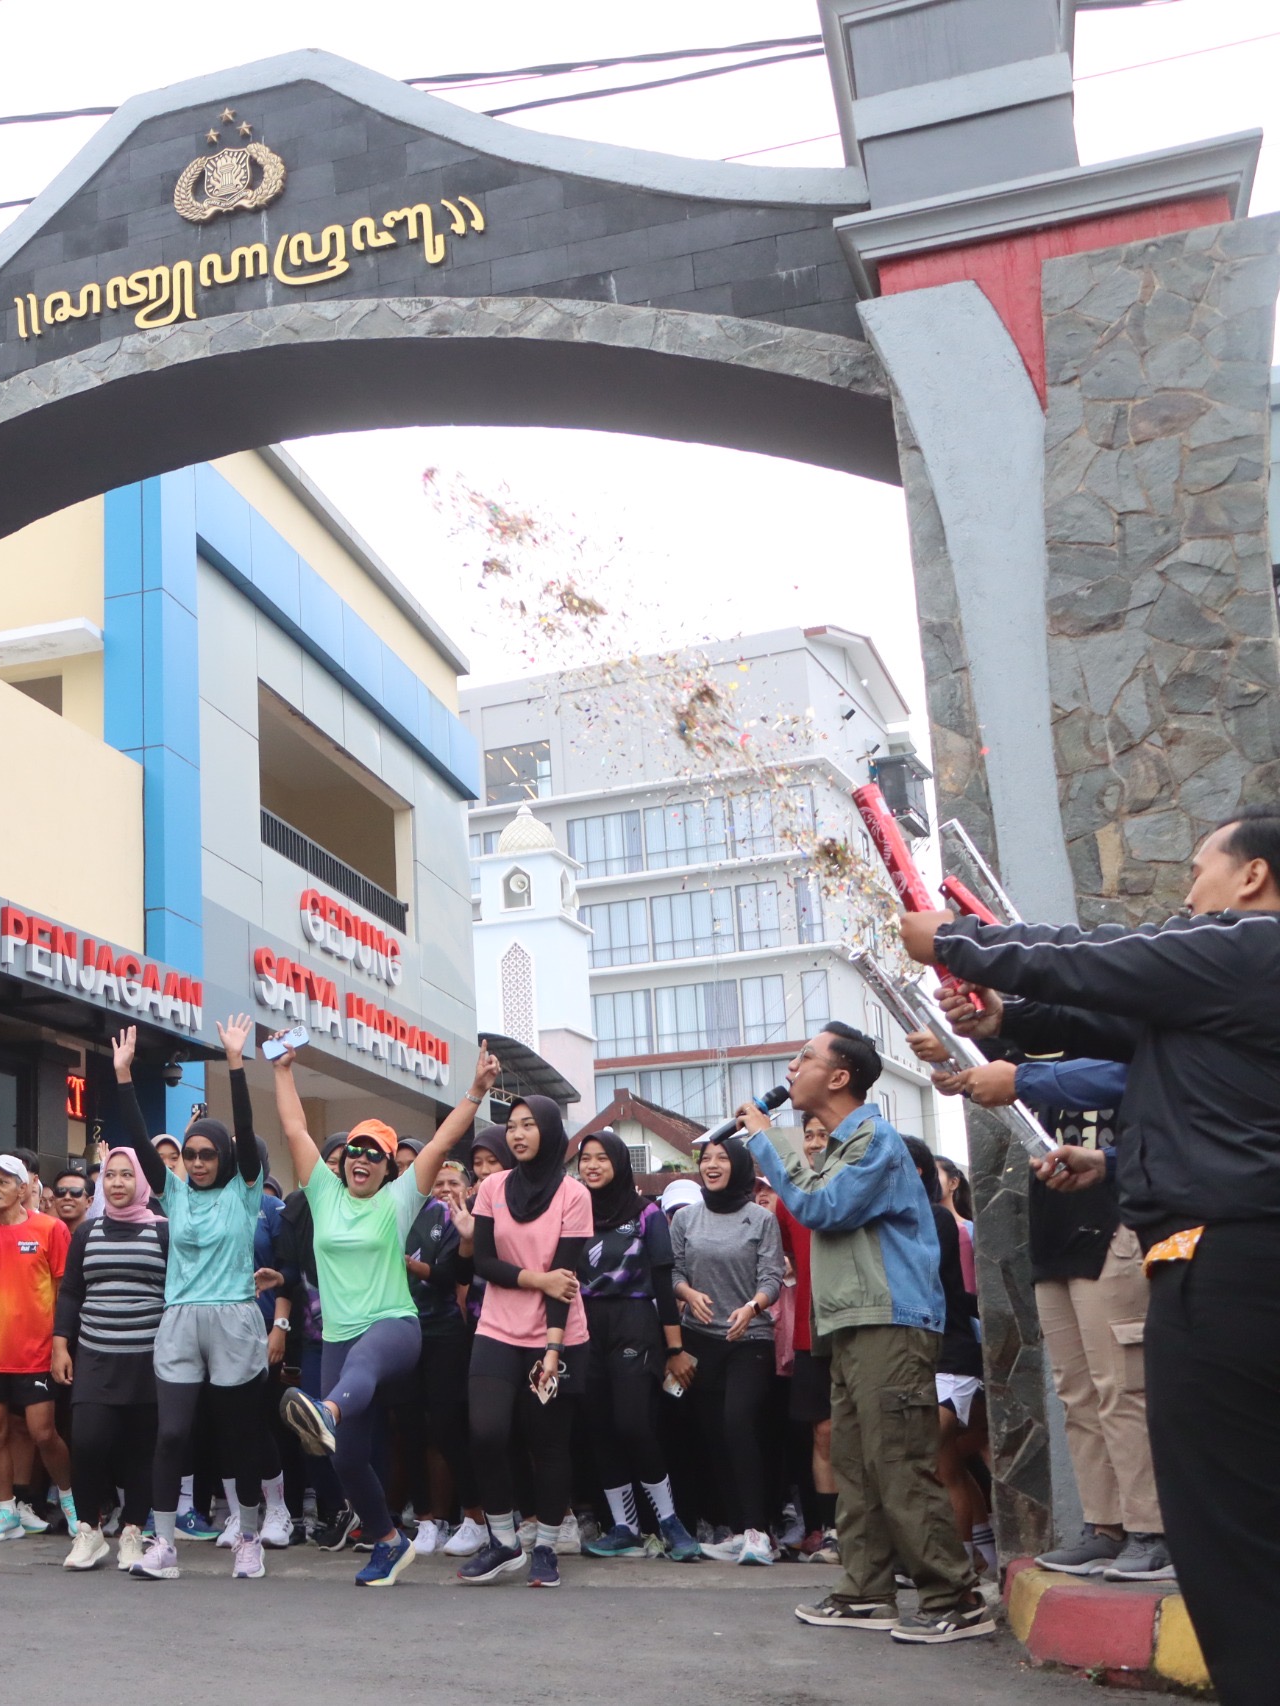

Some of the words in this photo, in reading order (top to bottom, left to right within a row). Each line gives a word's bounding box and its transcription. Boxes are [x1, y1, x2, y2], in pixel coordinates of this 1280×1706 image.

[1, 906, 203, 1031] PENJAGAAN
[300, 888, 403, 986] GEDUNG
[254, 947, 343, 1039] SATYA
[346, 992, 450, 1087] HAPRABU
